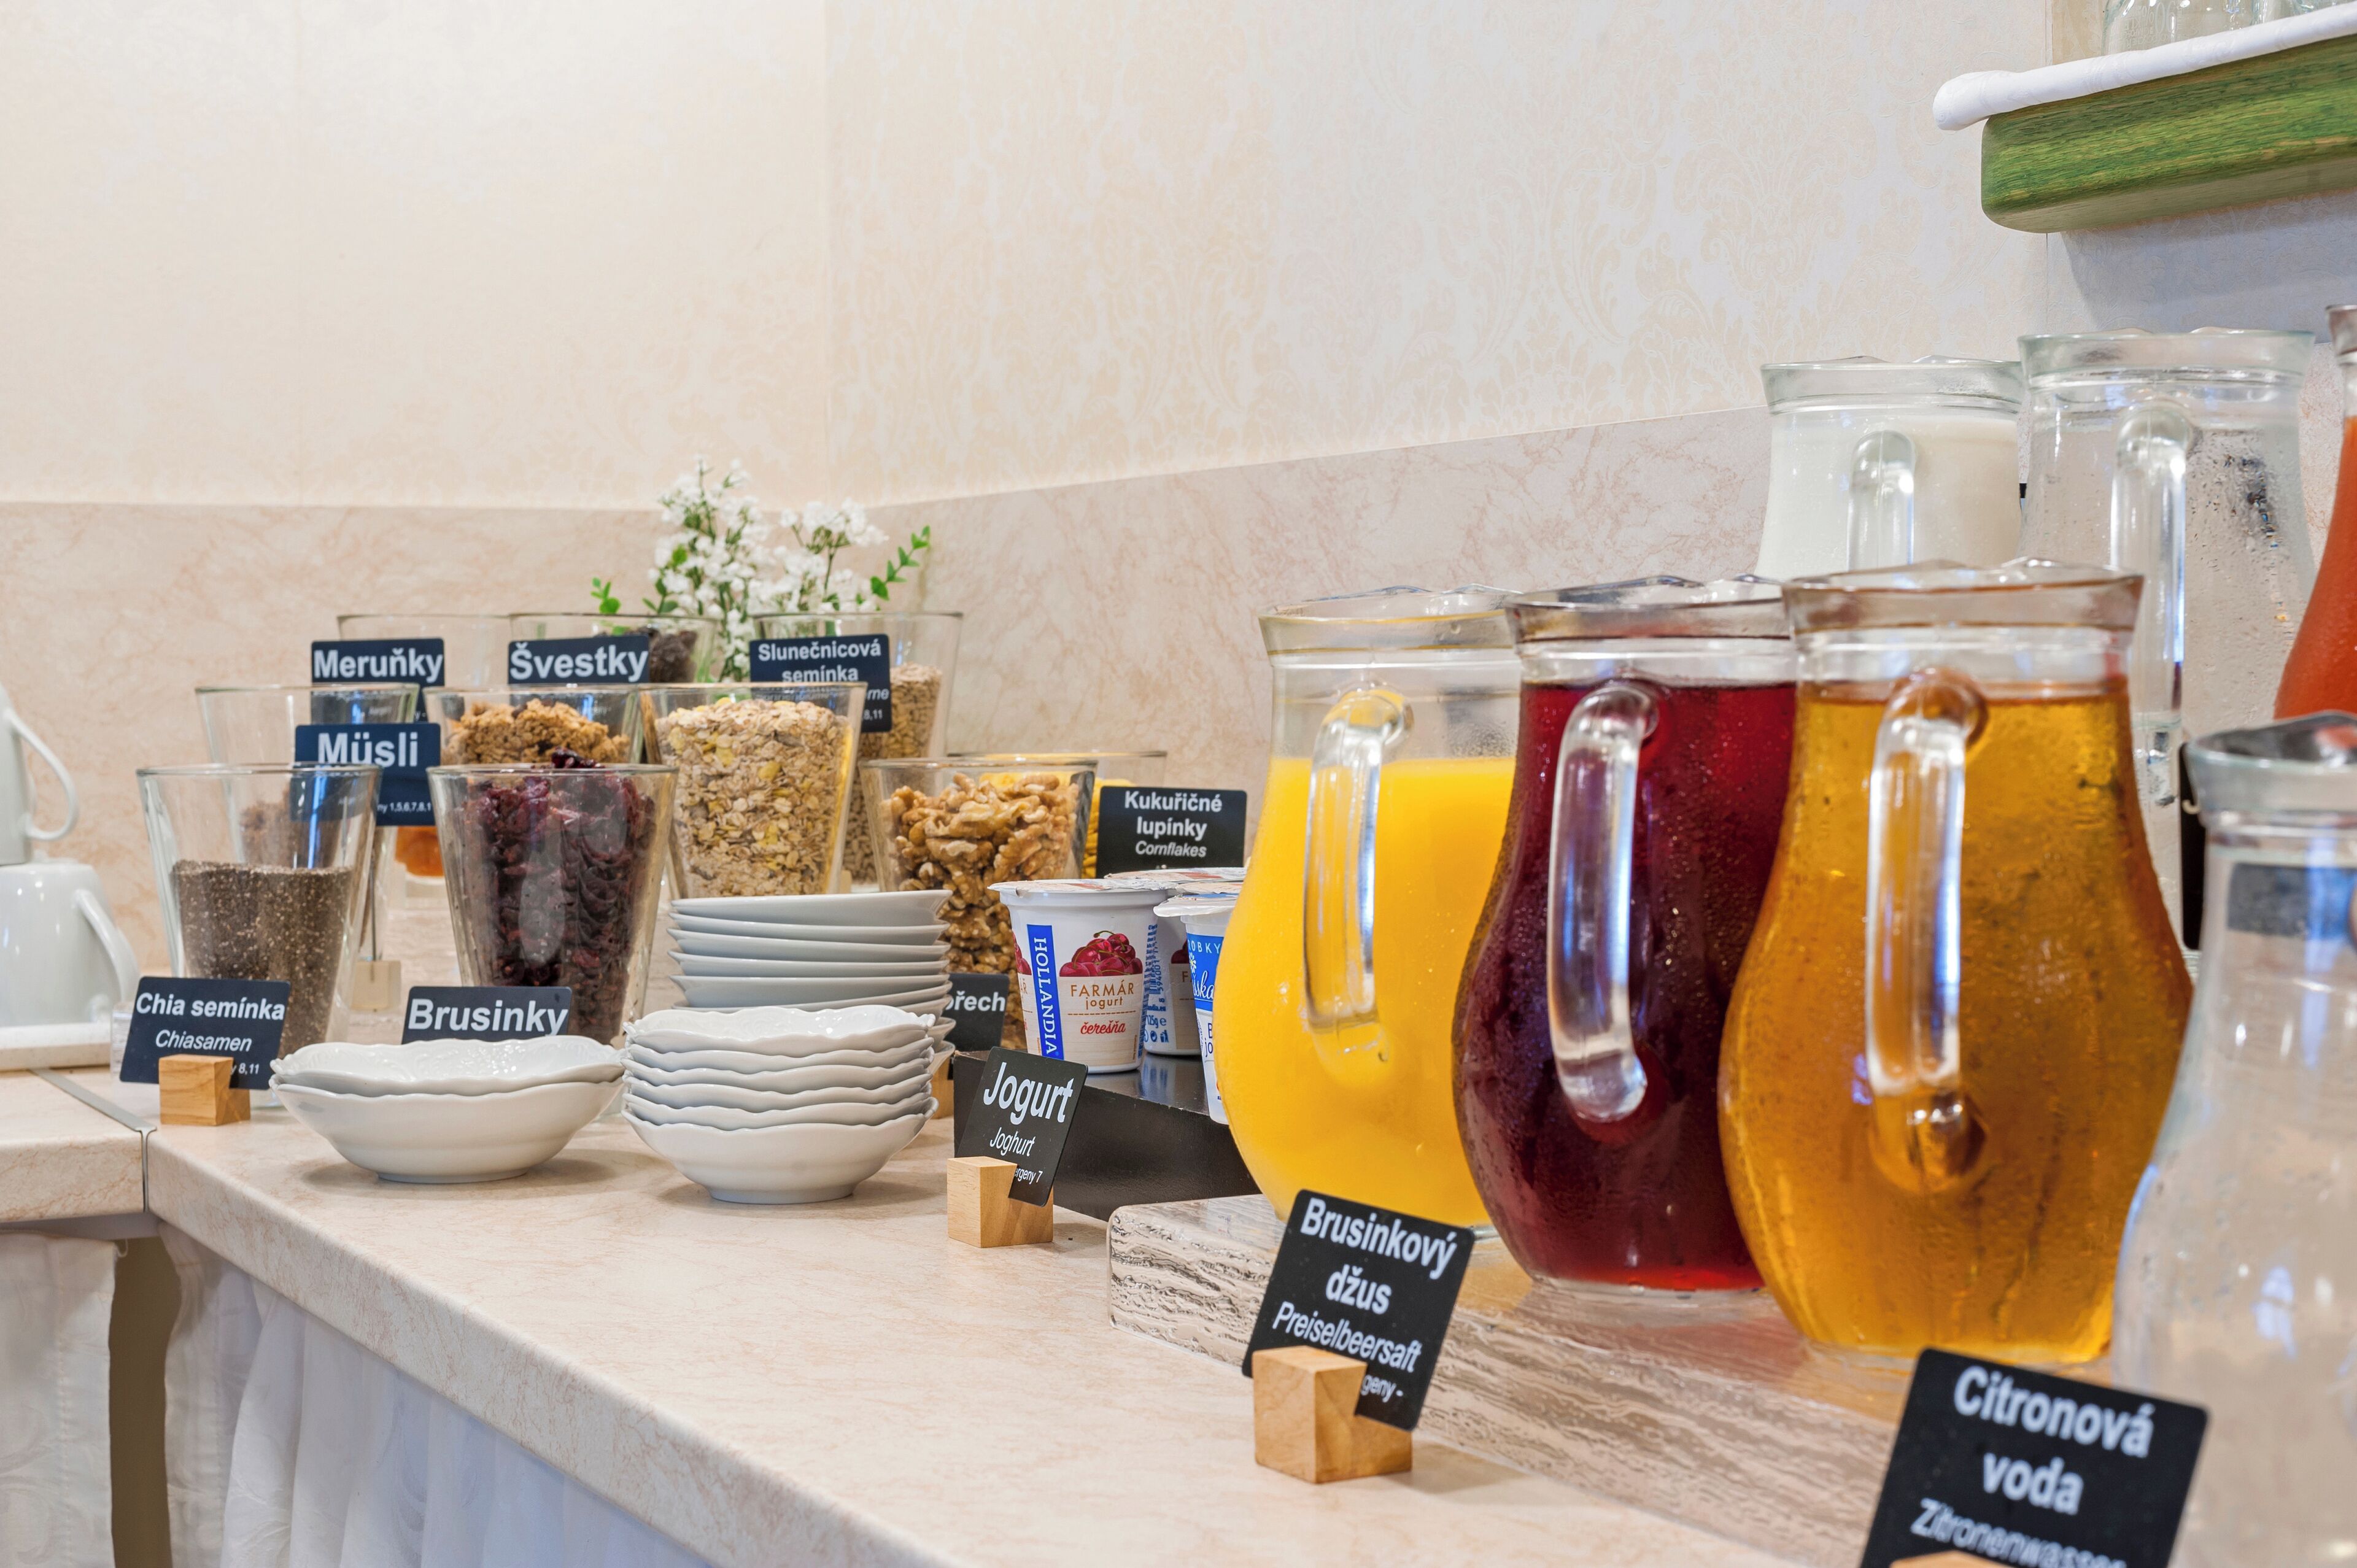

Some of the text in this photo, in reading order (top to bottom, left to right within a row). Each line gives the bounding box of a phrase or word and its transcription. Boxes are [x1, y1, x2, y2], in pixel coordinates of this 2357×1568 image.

[509, 641, 649, 682] Švestky
[758, 638, 881, 662] Slunečnicová
[314, 648, 443, 683] Meruňky
[782, 665, 858, 683] semínka
[317, 732, 418, 767] Müsli
[1124, 790, 1223, 813] Kukuřičné
[1137, 816, 1207, 841] lupínky
[1136, 840, 1207, 857] Cornflakes
[1034, 938, 1058, 1054] HOLLANDIA
[1070, 979, 1134, 997] FARMÁR
[136, 992, 285, 1020] Chia semínka
[408, 998, 569, 1037] Brusinky
[1086, 997, 1123, 1010] jogurt
[155, 1029, 252, 1052] Chiasamen
[1080, 1020, 1126, 1035] čerešňa
[983, 1062, 1074, 1126] Jogurt
[989, 1127, 1036, 1157] Joghurt
[1035, 1170, 1043, 1183] 7
[1300, 1197, 1457, 1280] Brusinkový
[1326, 1263, 1392, 1315] džus
[1272, 1301, 1423, 1373] Preiselbeersaft
[1954, 1365, 2155, 1459] Citronová
[1983, 1452, 2084, 1516] voda
